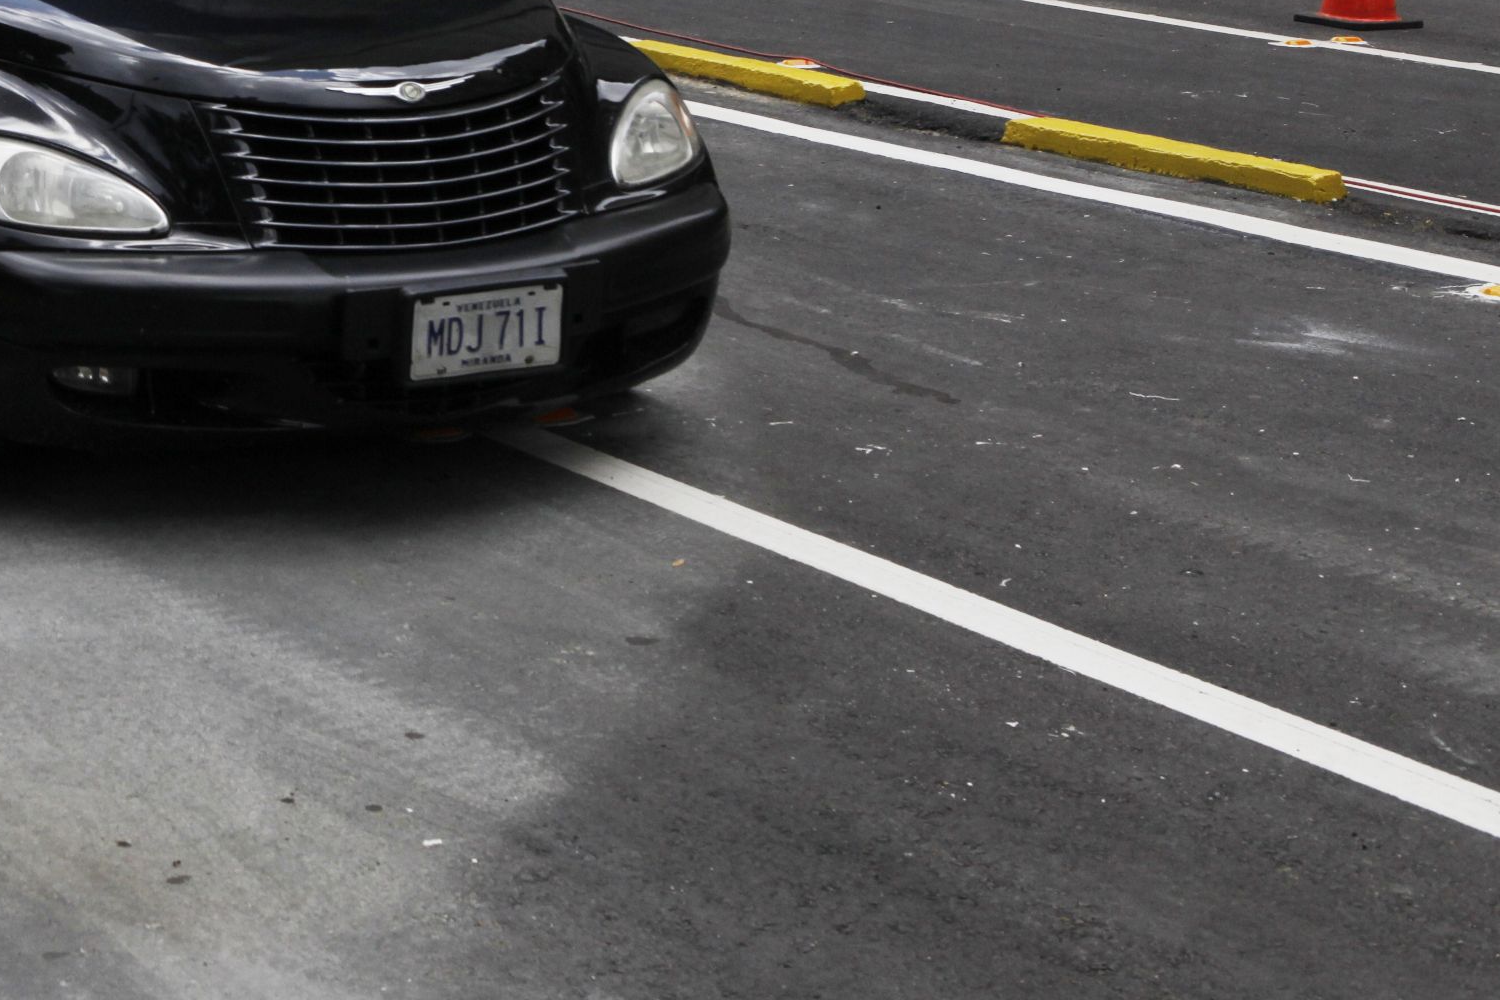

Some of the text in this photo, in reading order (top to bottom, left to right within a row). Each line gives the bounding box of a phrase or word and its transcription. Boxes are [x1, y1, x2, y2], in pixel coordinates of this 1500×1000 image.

[456, 297, 521, 313] VENEZUELA
[427, 313, 483, 358] MDJ
[461, 353, 512, 366] MIRANDA
